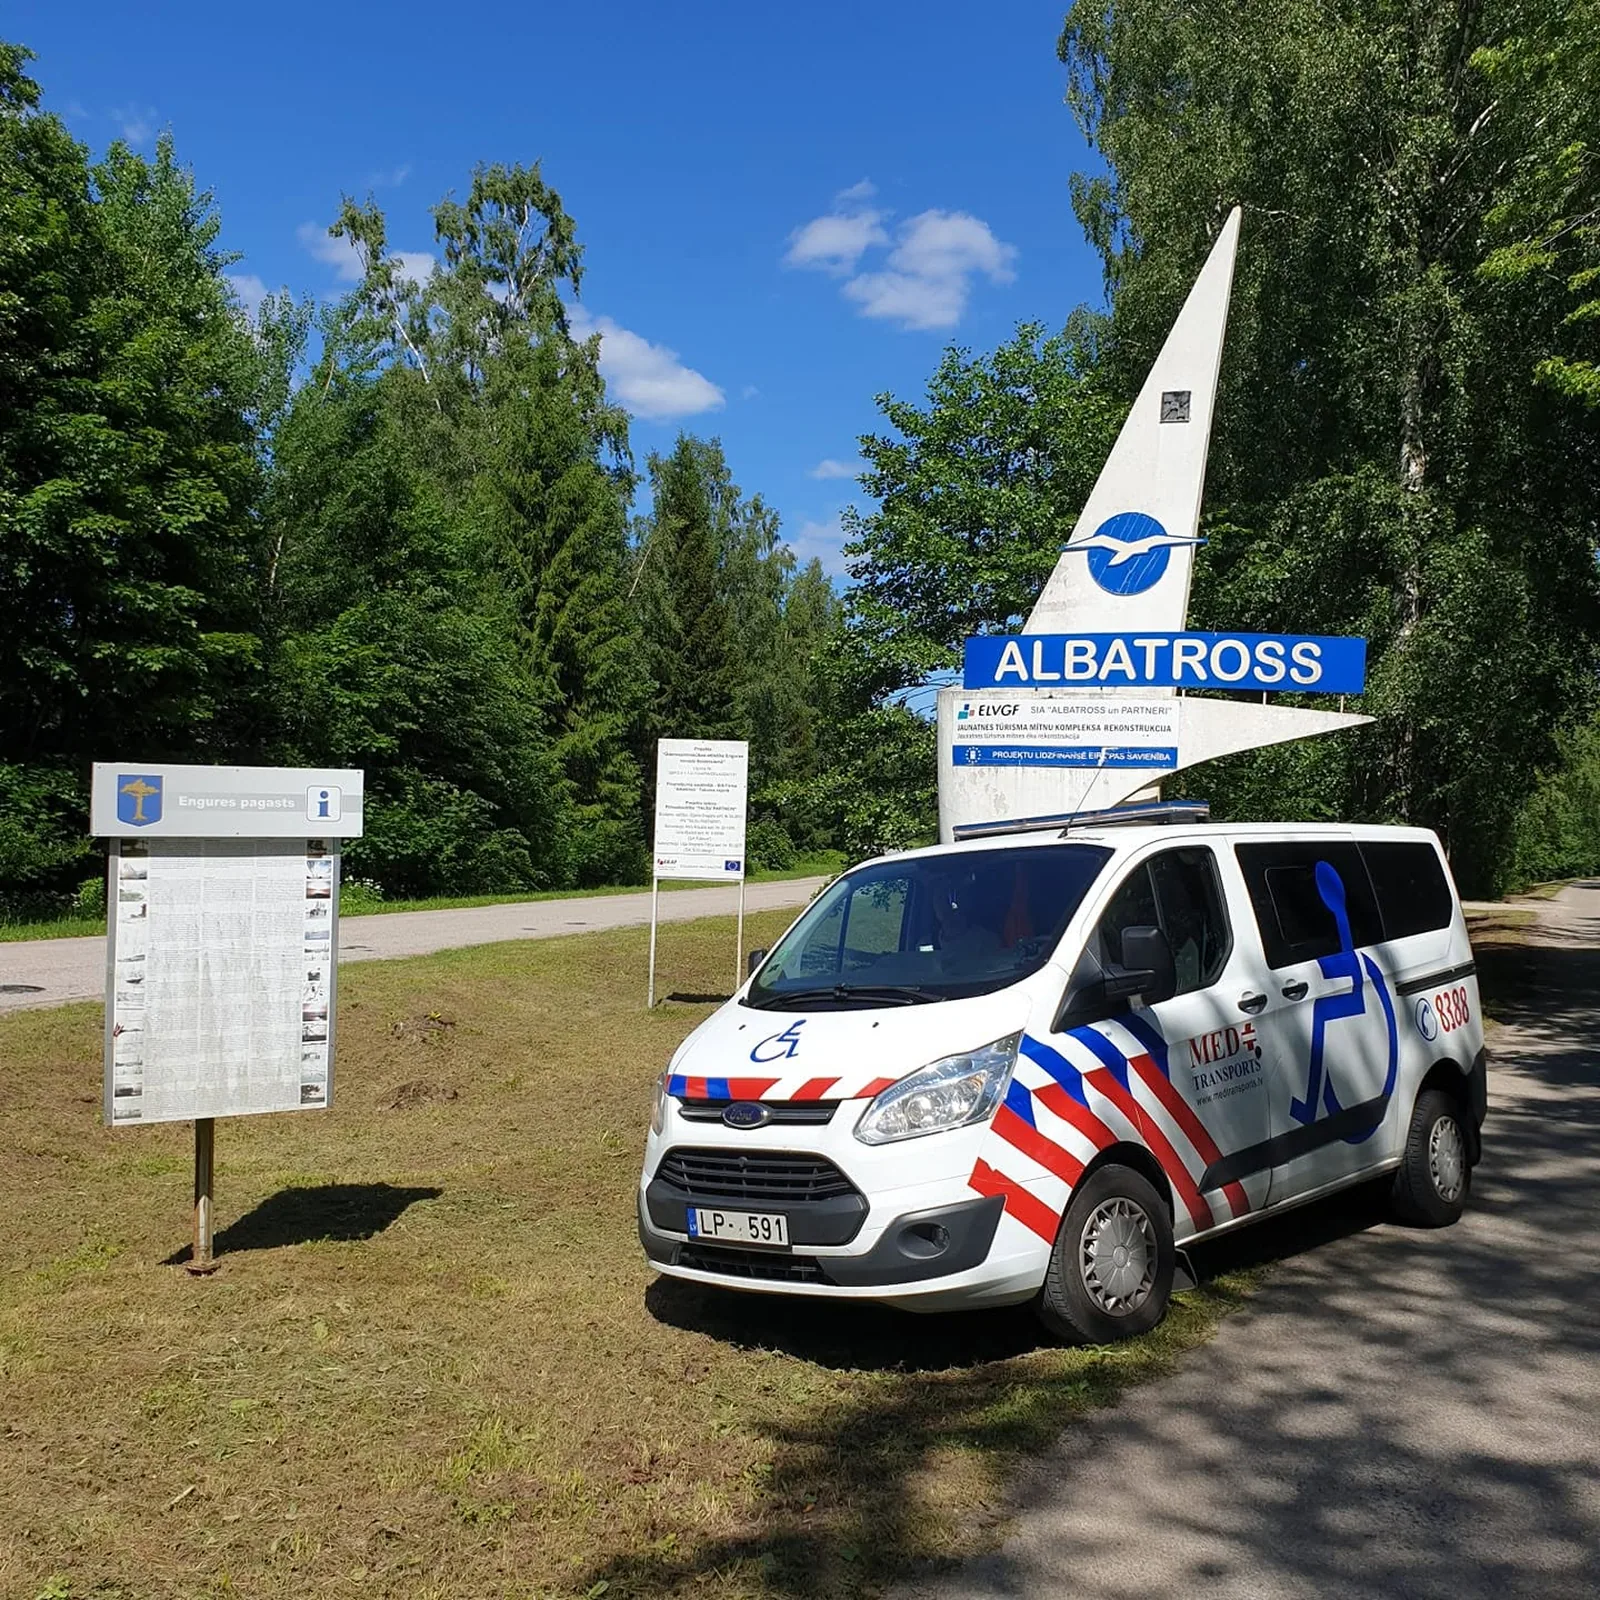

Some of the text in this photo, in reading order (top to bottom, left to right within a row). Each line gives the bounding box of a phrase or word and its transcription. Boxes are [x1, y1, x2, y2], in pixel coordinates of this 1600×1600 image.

[994, 638, 1322, 685] ALBATROSS
[978, 704, 1020, 716] ELVGF
[1030, 706, 1046, 714] SIA
[1055, 723, 1101, 731] KOMPLEKSA
[1103, 724, 1172, 732] REKONSTRUKCIJA
[992, 751, 1034, 759] PROJEKTU
[178, 796, 296, 810] Engures pagasts
[1435, 986, 1470, 1033] 8388
[1193, 1058, 1262, 1091] TRANSPORTS
[748, 1216, 783, 1242] 591
